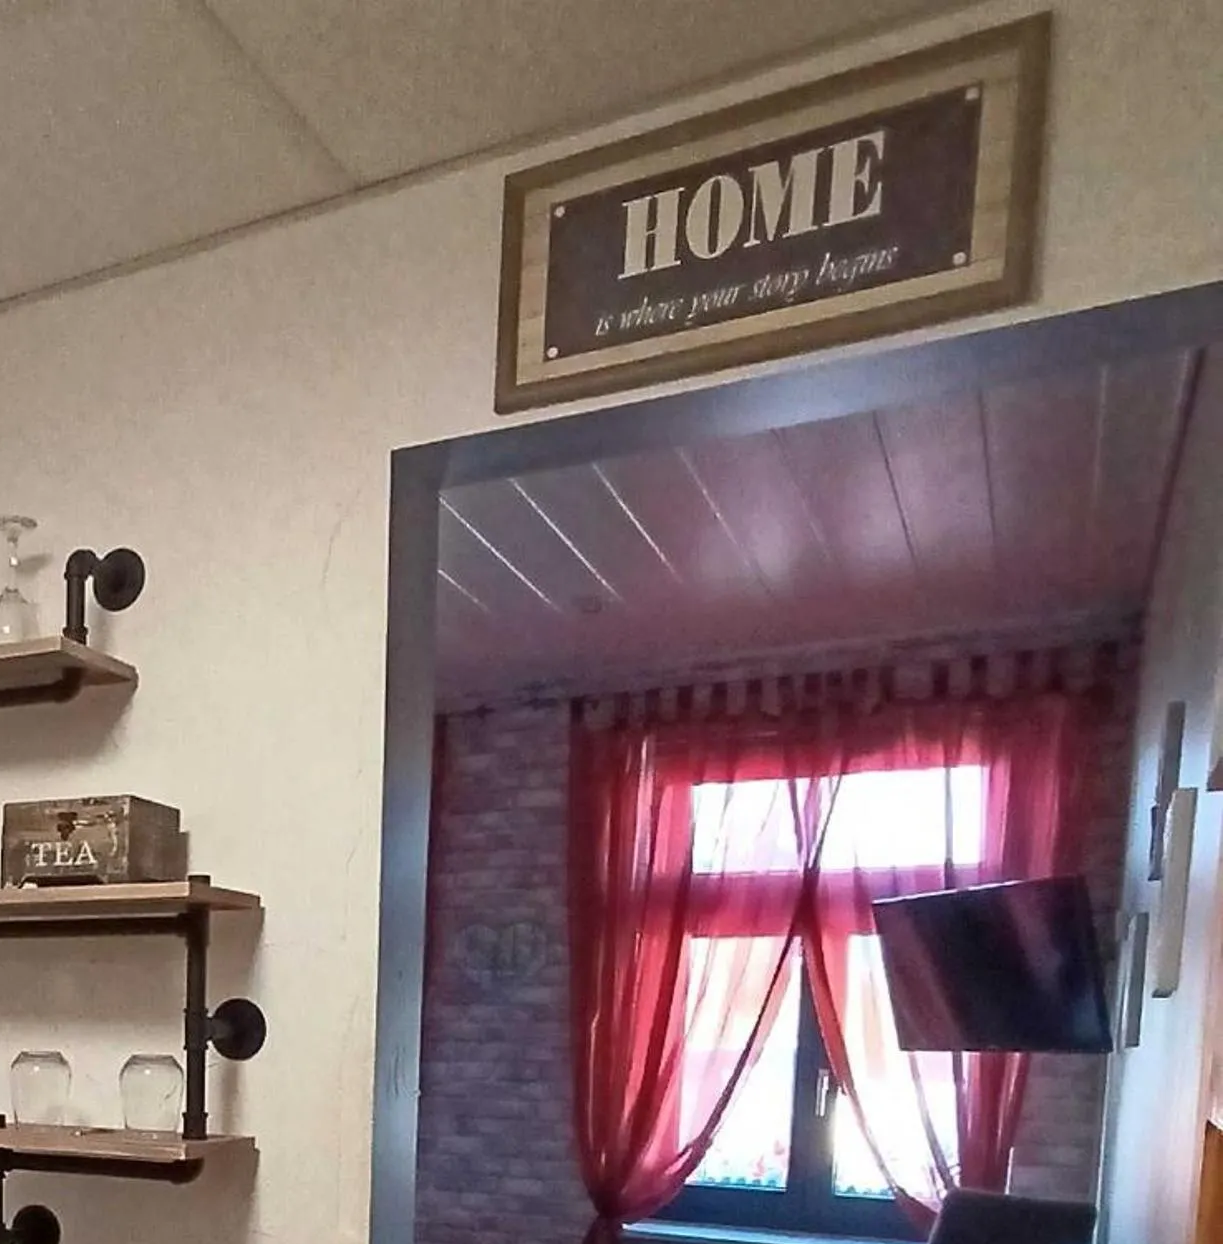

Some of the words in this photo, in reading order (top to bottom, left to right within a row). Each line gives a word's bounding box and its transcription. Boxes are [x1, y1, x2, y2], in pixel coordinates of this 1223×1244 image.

[618, 130, 886, 280] HOME
[595, 314, 613, 337] is
[620, 296, 684, 330] where
[685, 284, 747, 326] your
[748, 269, 810, 303] story
[815, 246, 899, 292] begins
[30, 841, 97, 867] TEA
